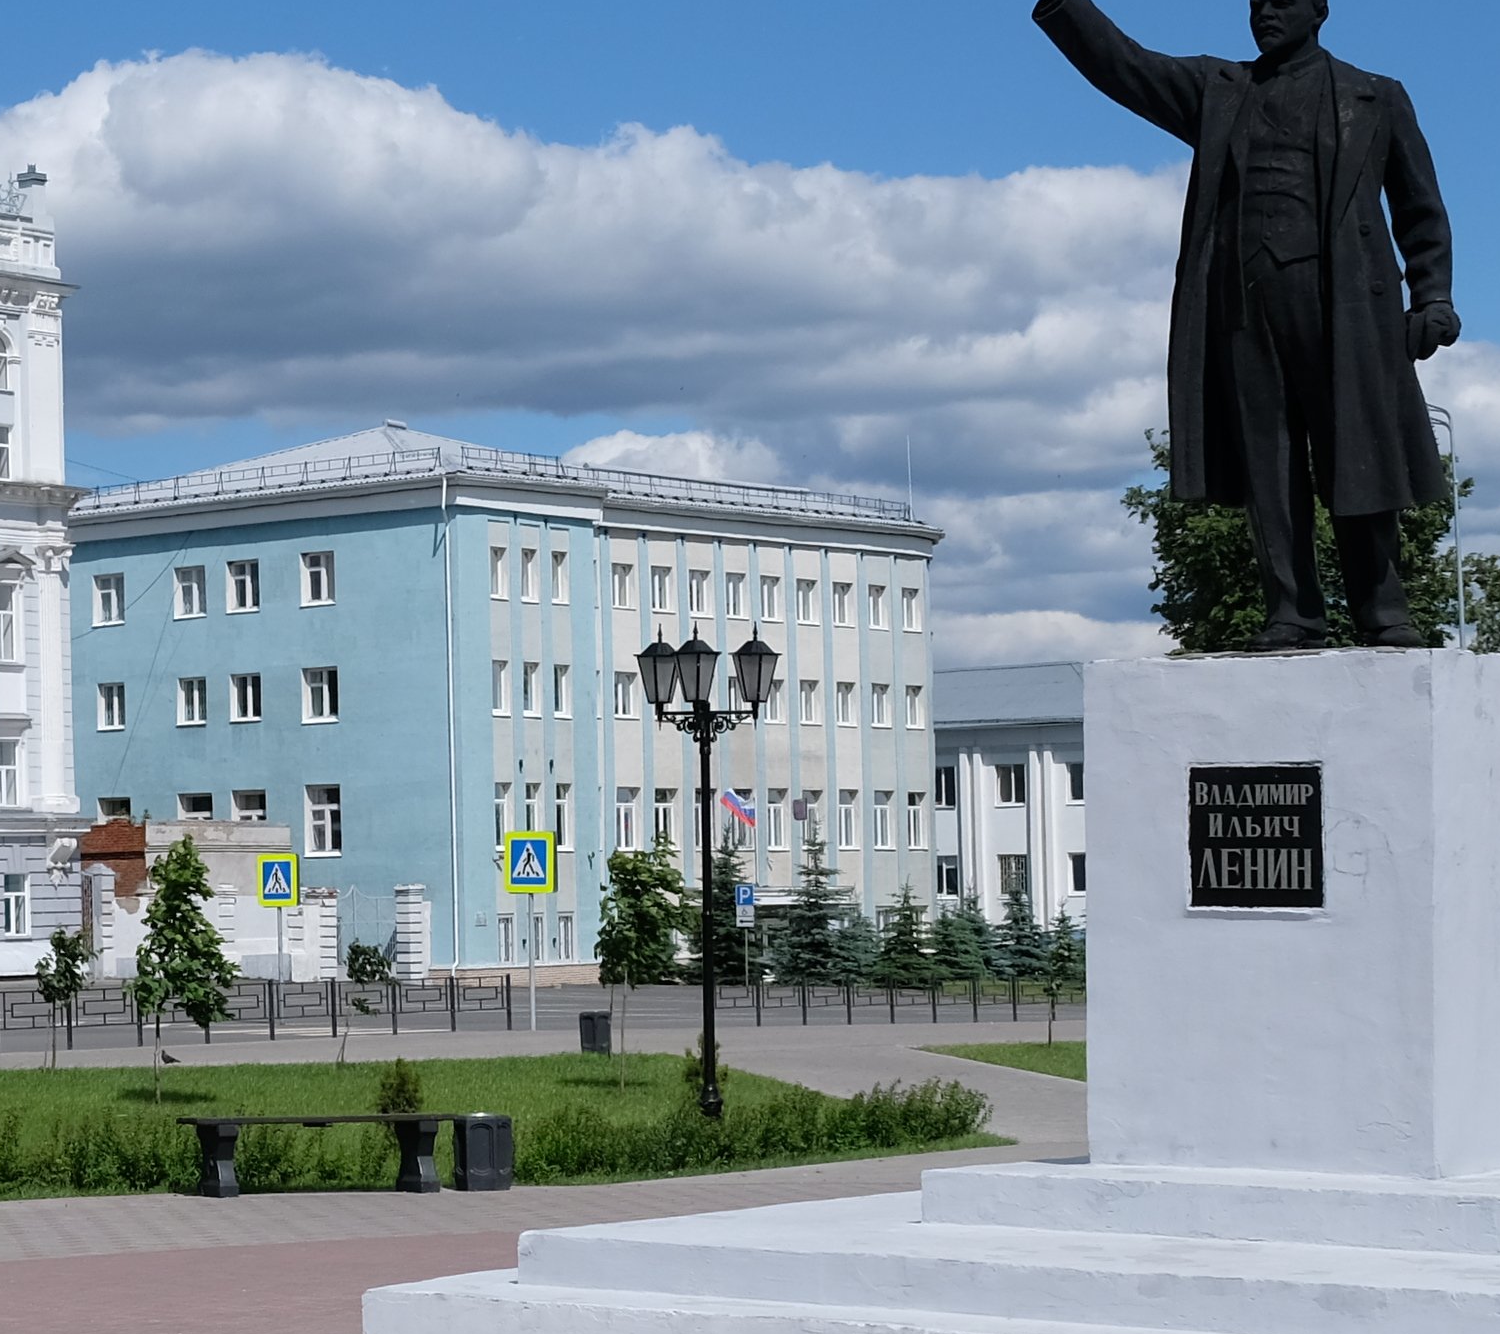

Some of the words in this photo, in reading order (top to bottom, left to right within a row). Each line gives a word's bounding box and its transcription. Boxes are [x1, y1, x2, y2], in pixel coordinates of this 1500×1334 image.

[1194, 781, 1315, 809] ВЛАДИМИР
[1207, 812, 1301, 838] ИЛЬИЧ
[1196, 847, 1314, 891] ЛЕНИН
